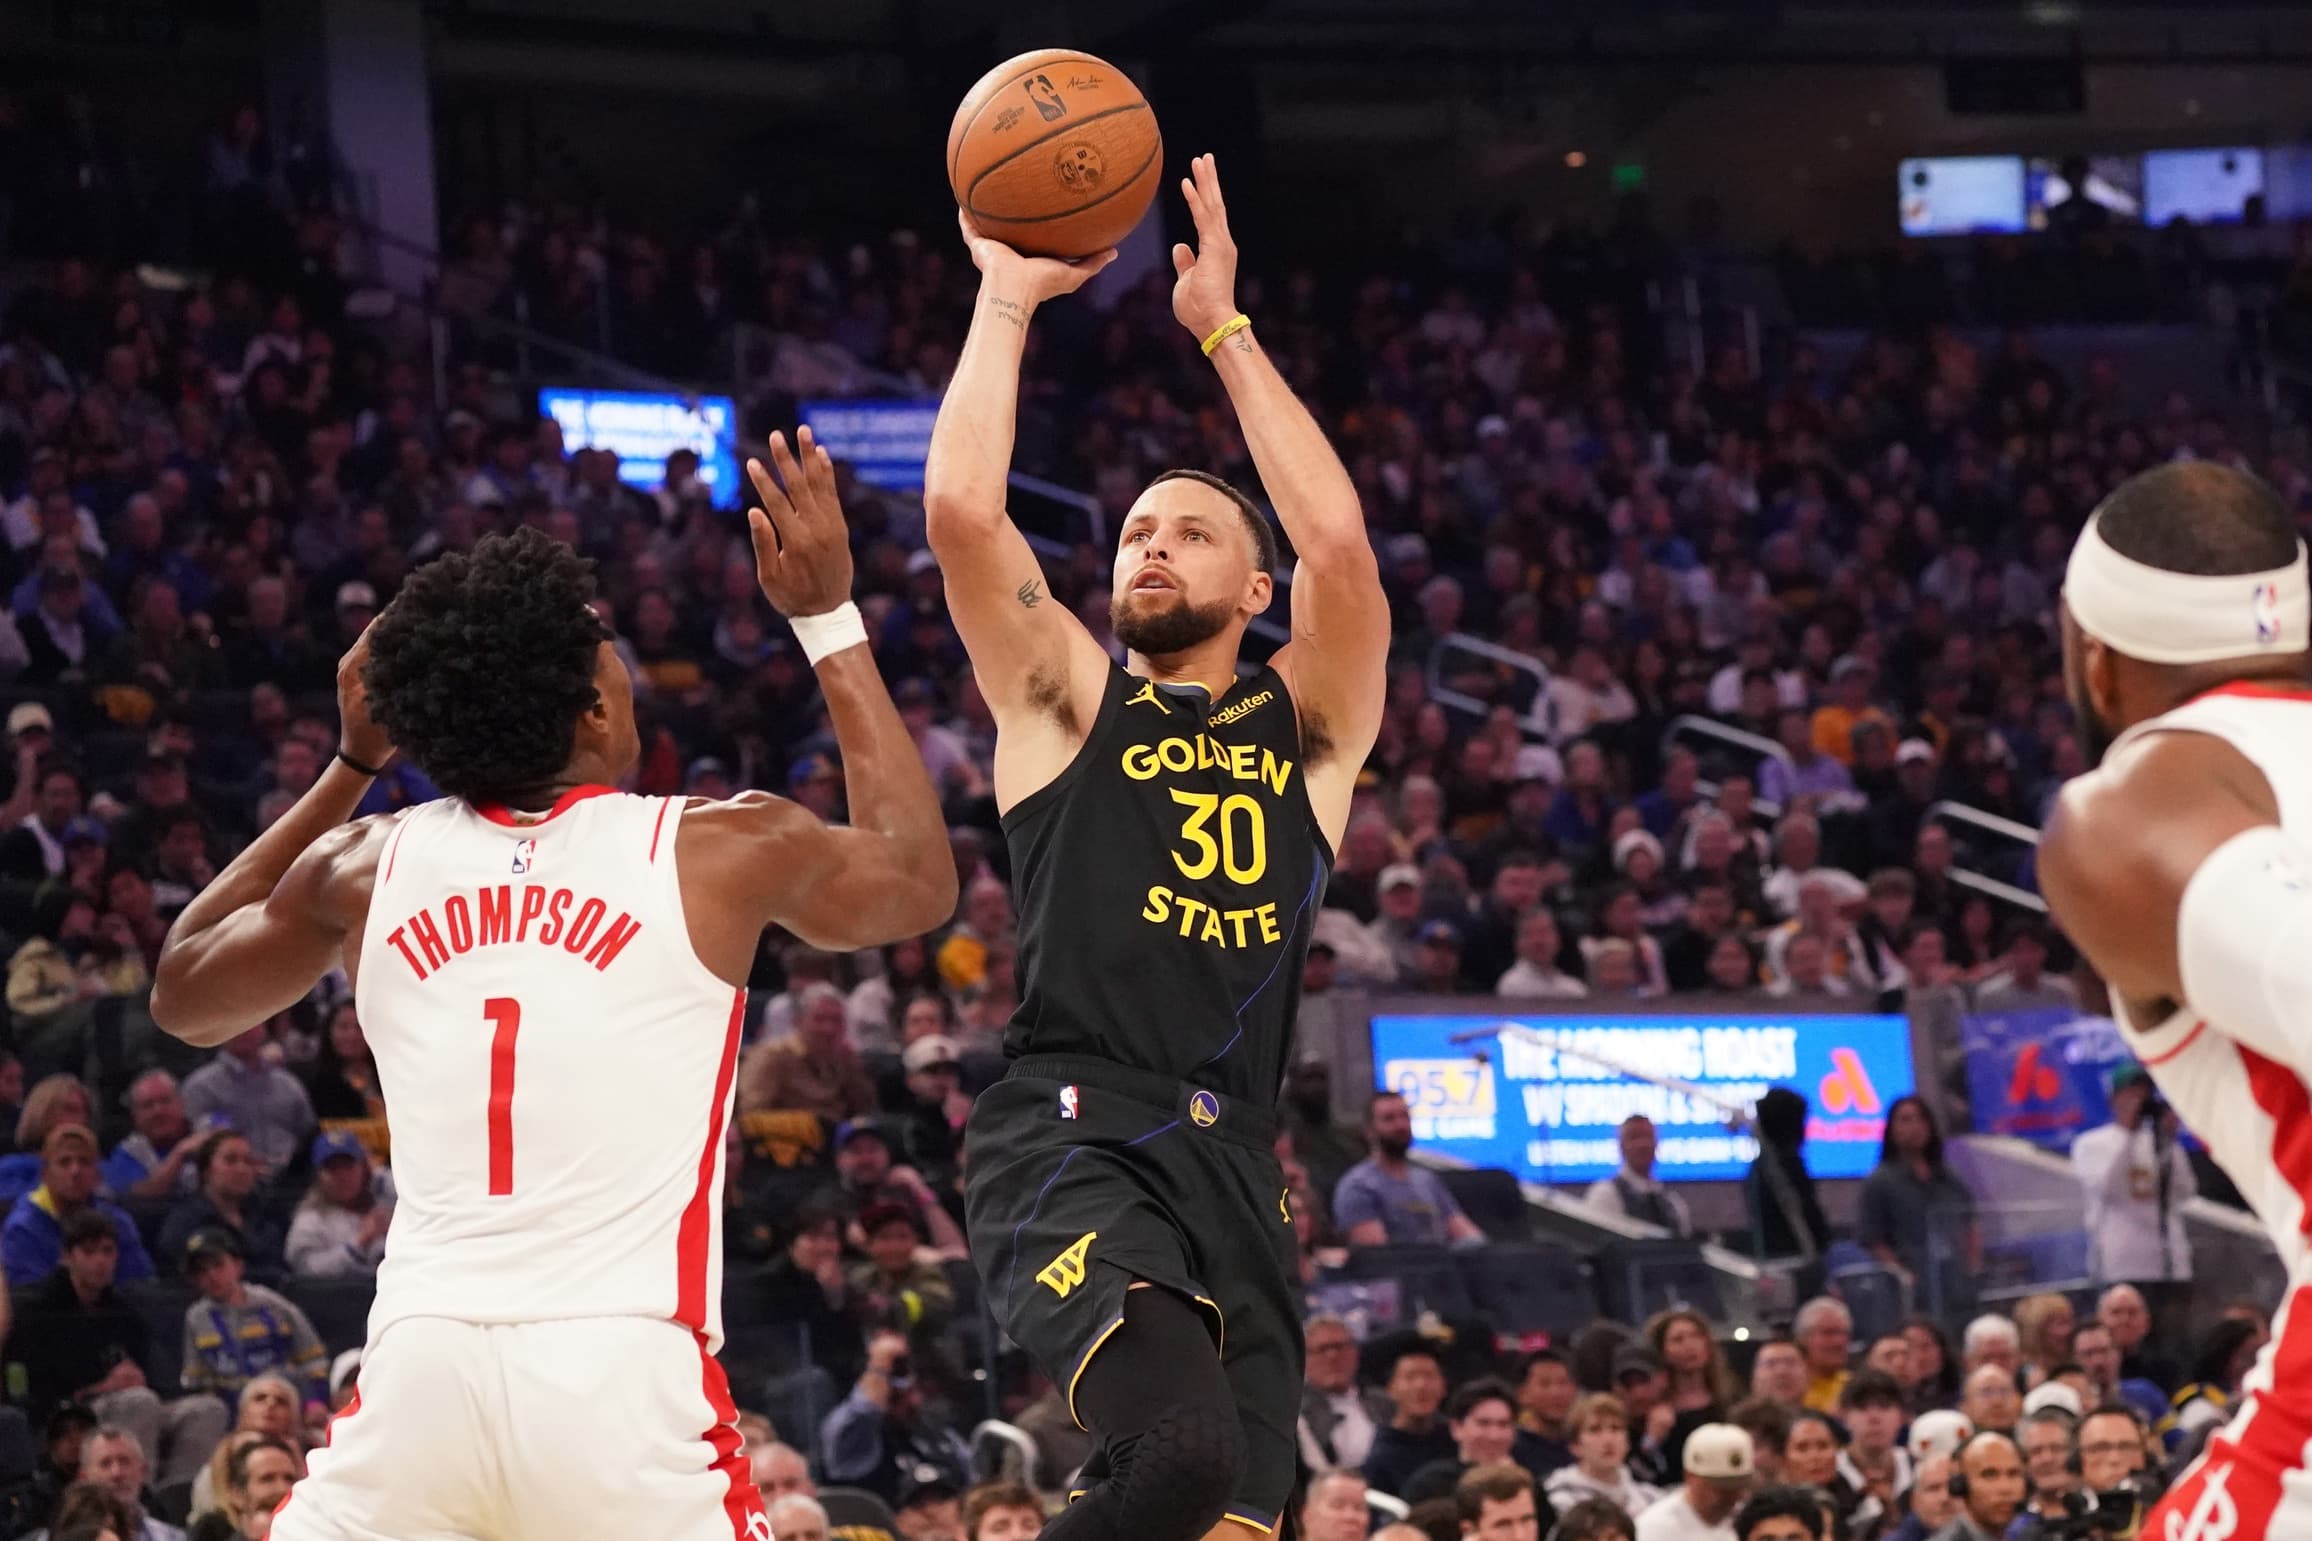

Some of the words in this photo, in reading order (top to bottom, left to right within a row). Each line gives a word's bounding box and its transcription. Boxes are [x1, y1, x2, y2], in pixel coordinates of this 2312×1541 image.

[1207, 688, 1273, 728] Rakuten
[1121, 733, 1293, 797] GOLDEN
[1170, 787, 1267, 885] 30
[386, 884, 642, 981] THOMPSON
[1143, 885, 1280, 949] STATE
[484, 997, 521, 1196] 1
